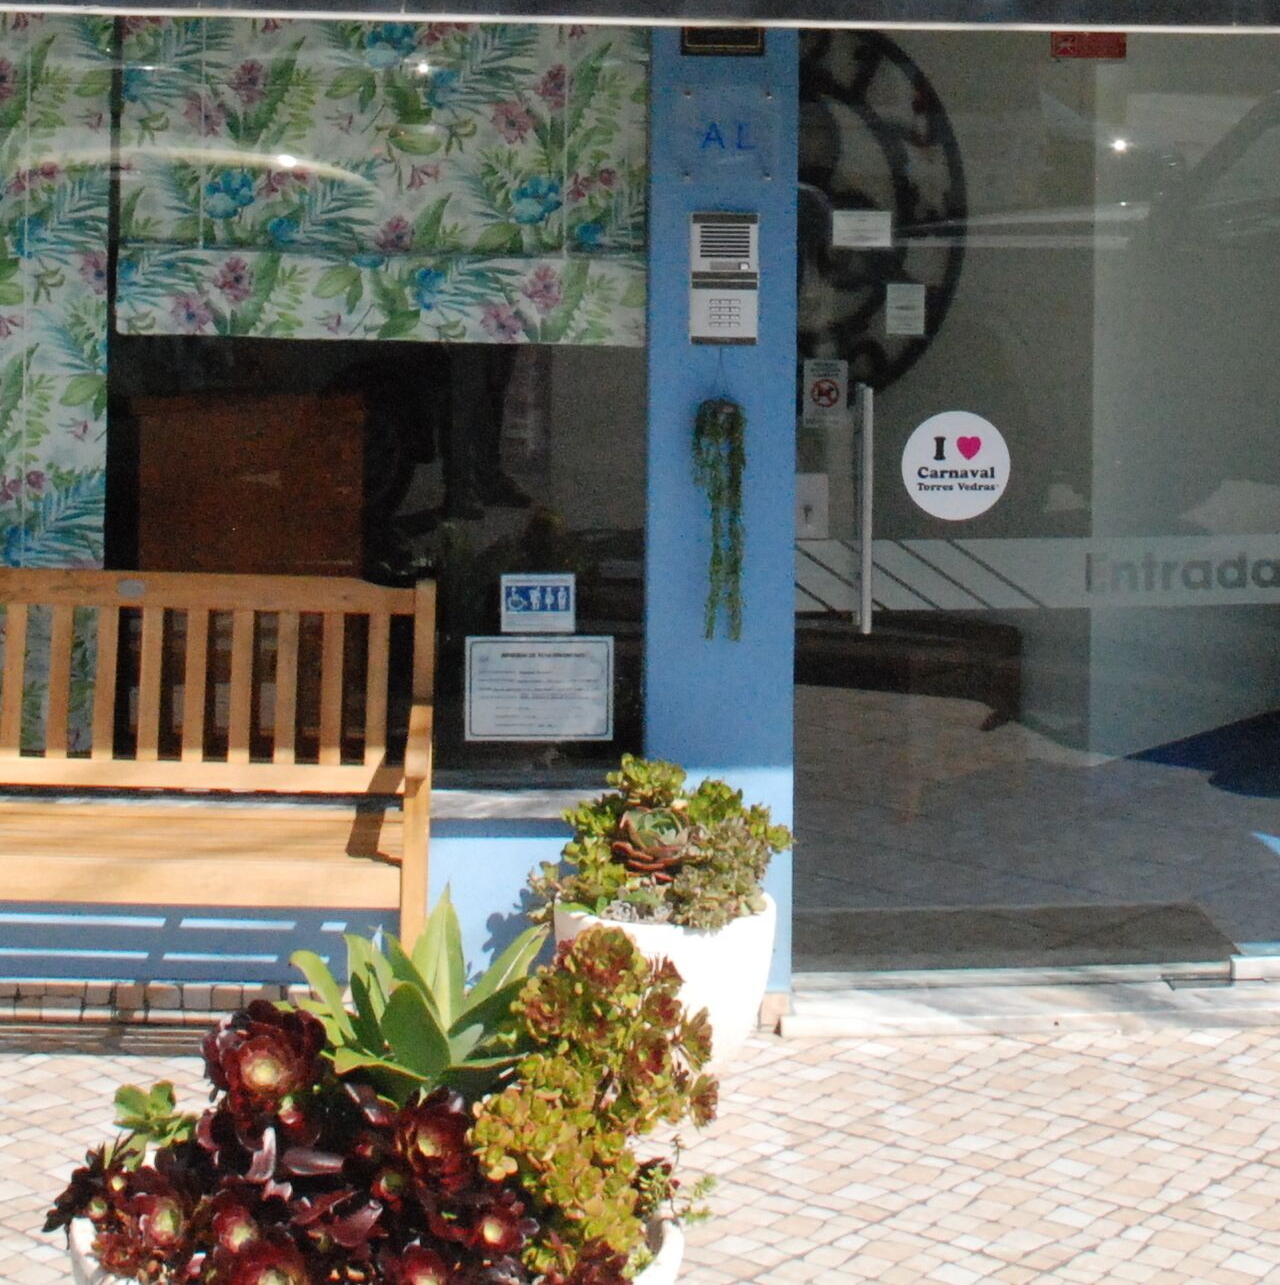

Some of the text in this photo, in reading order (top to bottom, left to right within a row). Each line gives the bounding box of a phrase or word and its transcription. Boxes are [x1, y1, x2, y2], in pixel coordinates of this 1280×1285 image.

[917, 466, 996, 480] Carnaval
[917, 482, 996, 492] Torres Vedras
